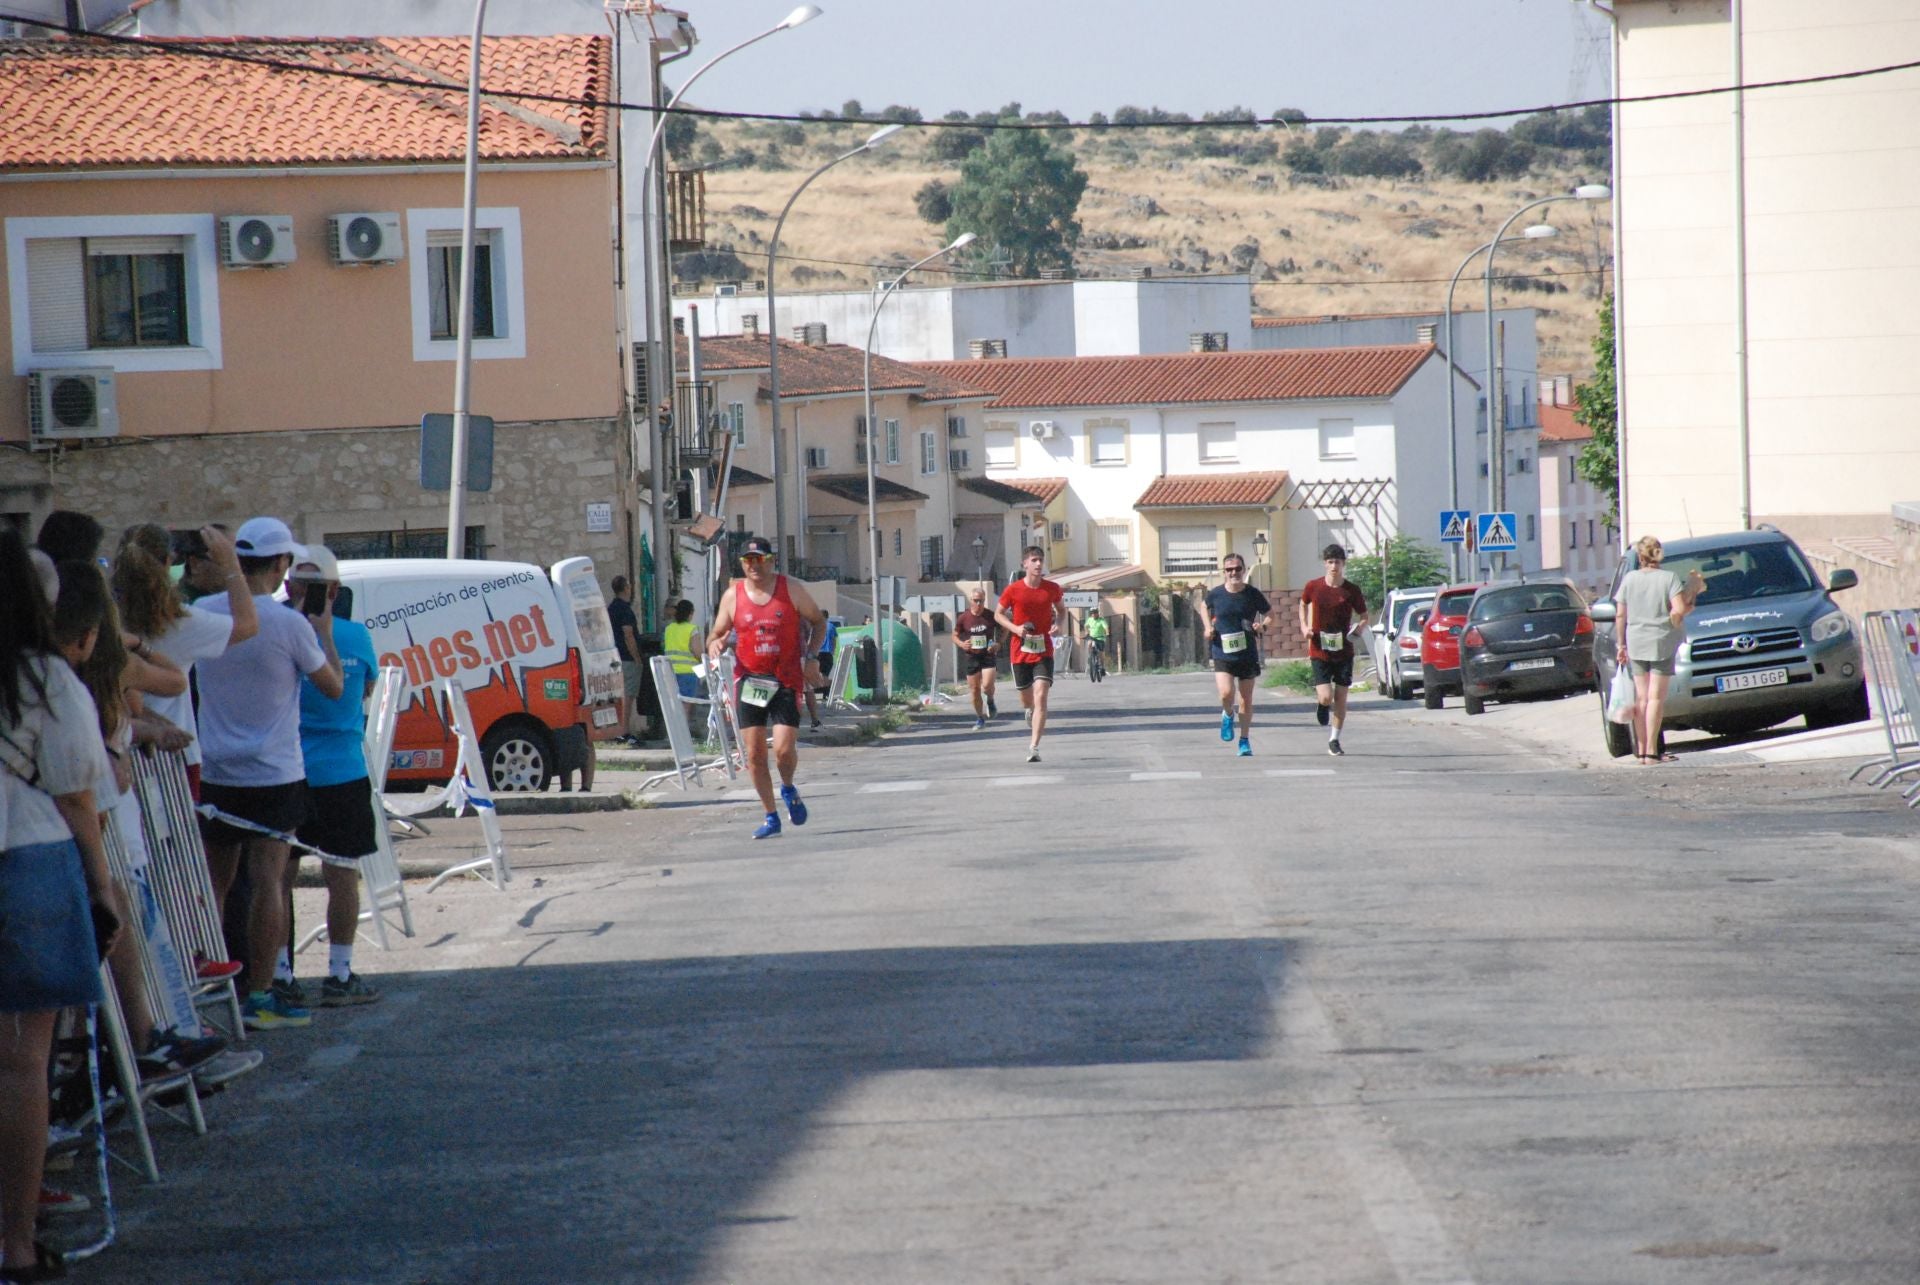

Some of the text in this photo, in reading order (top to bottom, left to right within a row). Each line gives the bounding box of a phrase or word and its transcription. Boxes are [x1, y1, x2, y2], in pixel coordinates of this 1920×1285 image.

[365, 569, 535, 630] organización de eventos
[1229, 639, 1239, 649] 69
[1725, 671, 1785, 689] 1131 GGP
